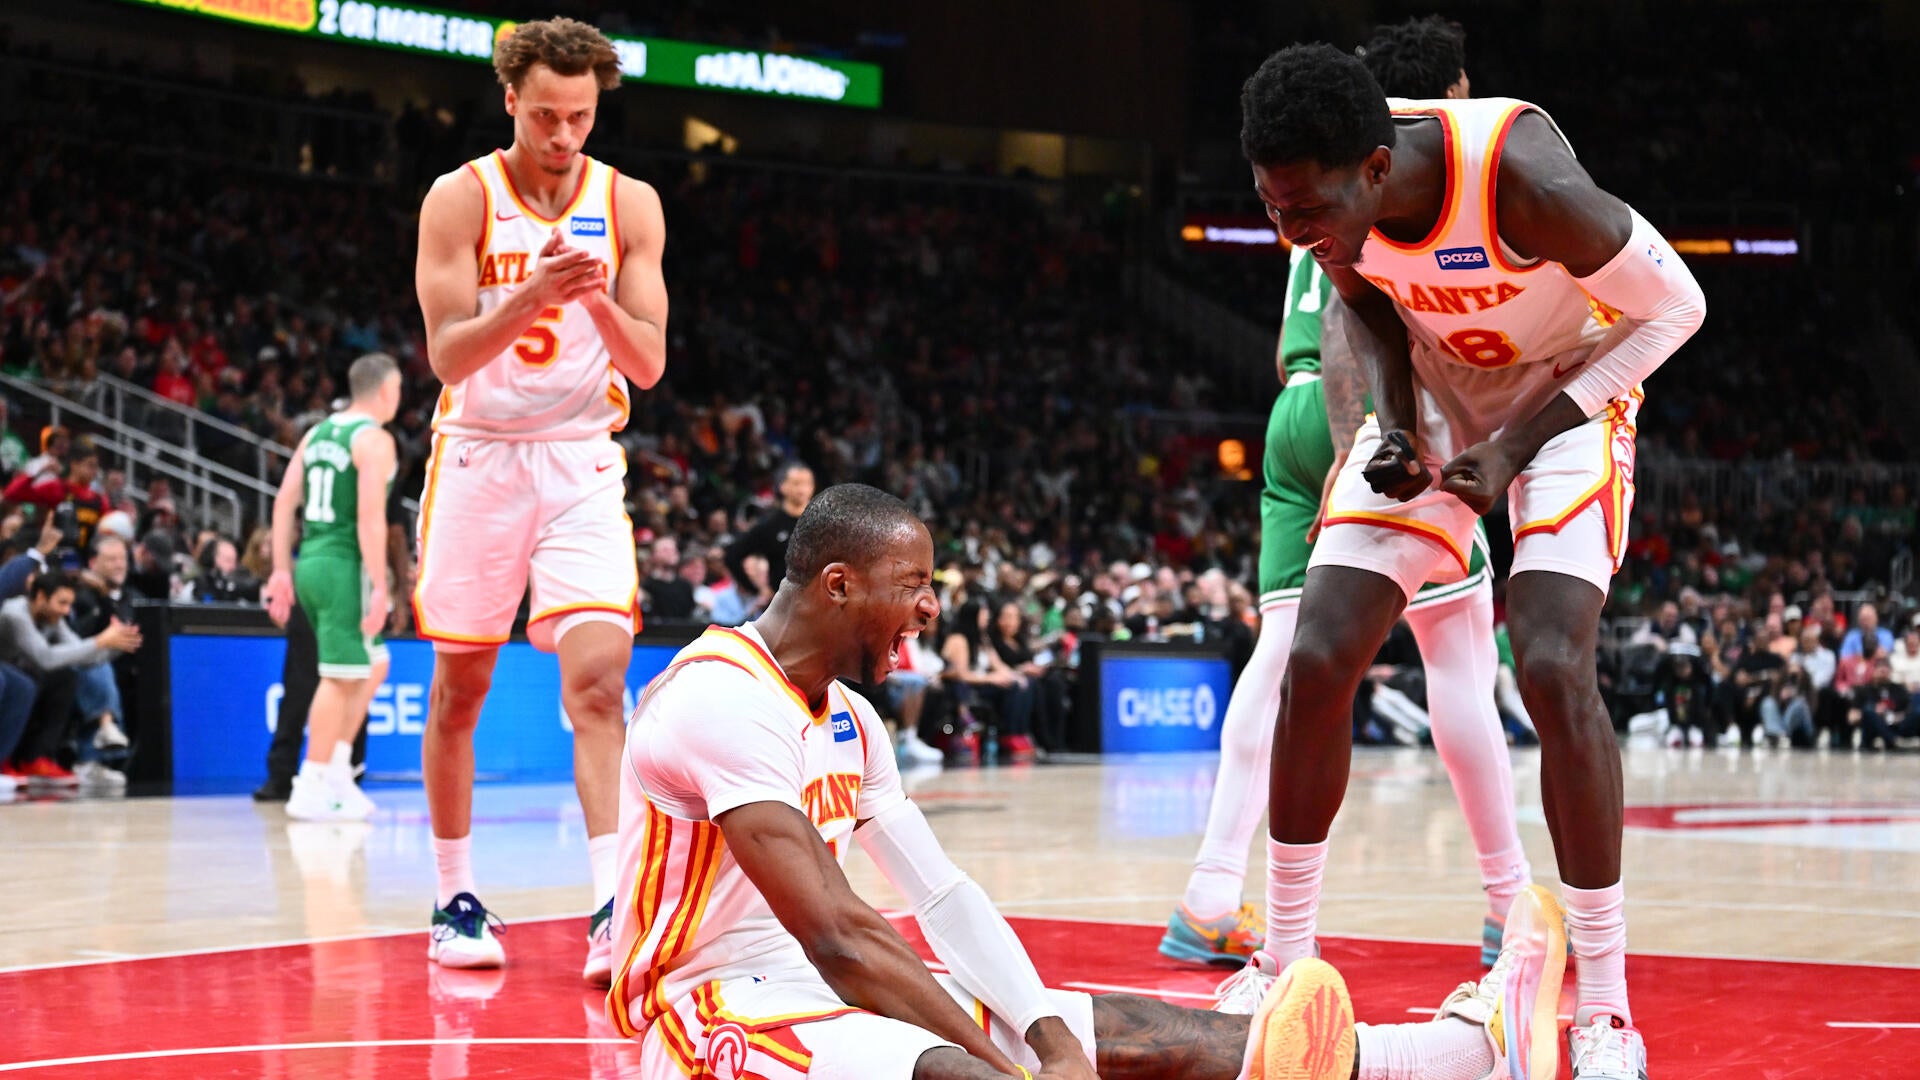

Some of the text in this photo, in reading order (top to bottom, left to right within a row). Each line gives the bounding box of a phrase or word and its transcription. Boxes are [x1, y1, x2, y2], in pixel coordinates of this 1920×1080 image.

[318, 0, 339, 34] 2
[376, 6, 447, 51] MORE
[572, 221, 603, 232] paze
[1439, 252, 1484, 266] paze
[1361, 272, 1527, 315] TLANTA
[514, 304, 563, 368] 5
[1438, 328, 1522, 371] 8
[305, 465, 336, 523] 11
[1117, 687, 1194, 727] CHASE
